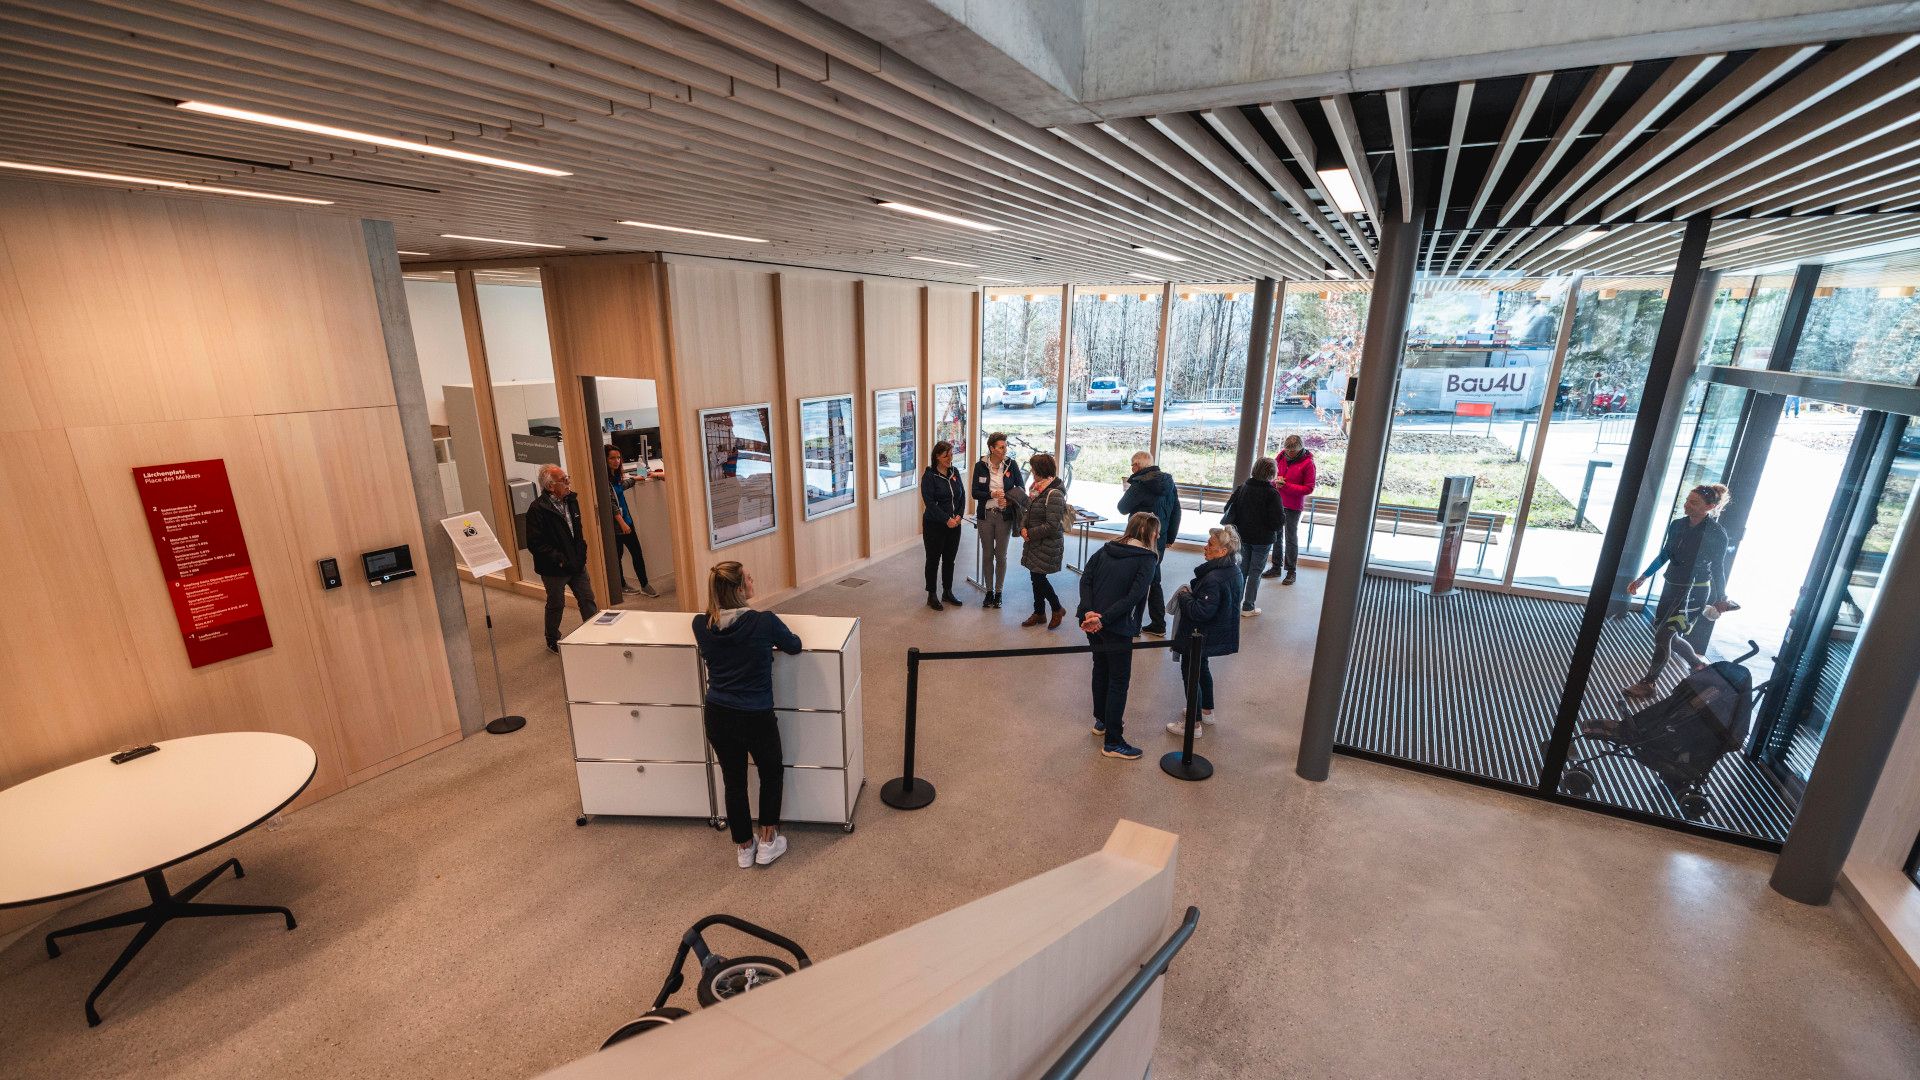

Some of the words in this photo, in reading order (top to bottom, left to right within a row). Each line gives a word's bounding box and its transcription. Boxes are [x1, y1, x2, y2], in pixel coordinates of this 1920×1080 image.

[1446, 372, 1527, 393] Bau4U
[143, 469, 186, 478] Lärchenplatz
[175, 473, 201, 481] Mélèzes
